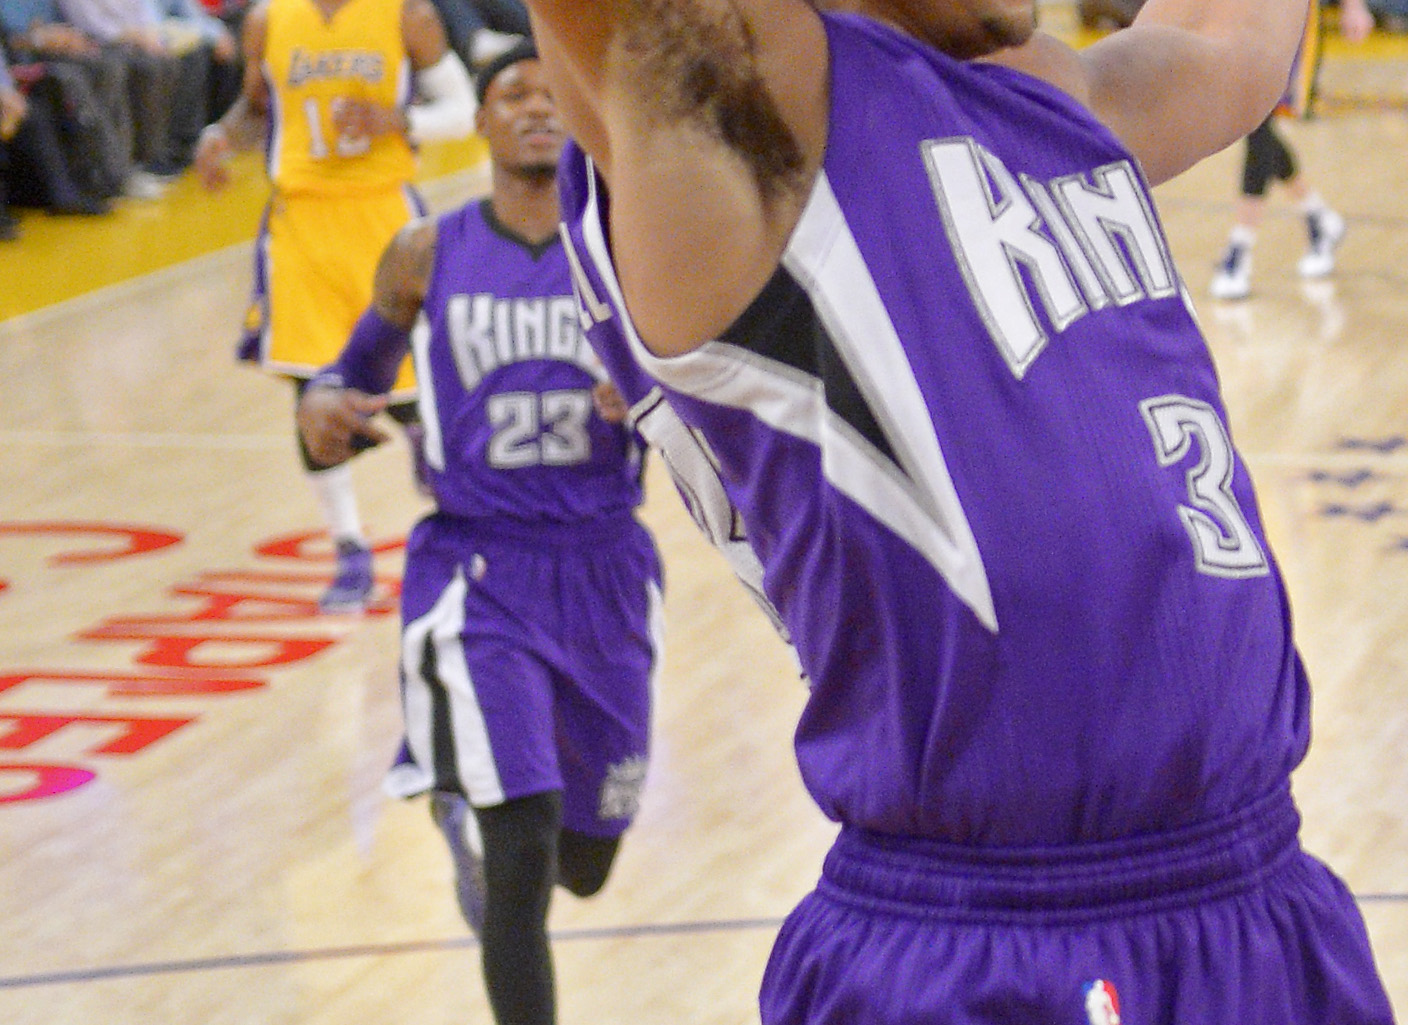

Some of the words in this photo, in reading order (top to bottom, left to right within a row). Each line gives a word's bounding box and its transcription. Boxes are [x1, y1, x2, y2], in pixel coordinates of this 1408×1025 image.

[918, 134, 1200, 381] KIN
[487, 390, 593, 470] 23
[1139, 393, 1271, 578] 3
